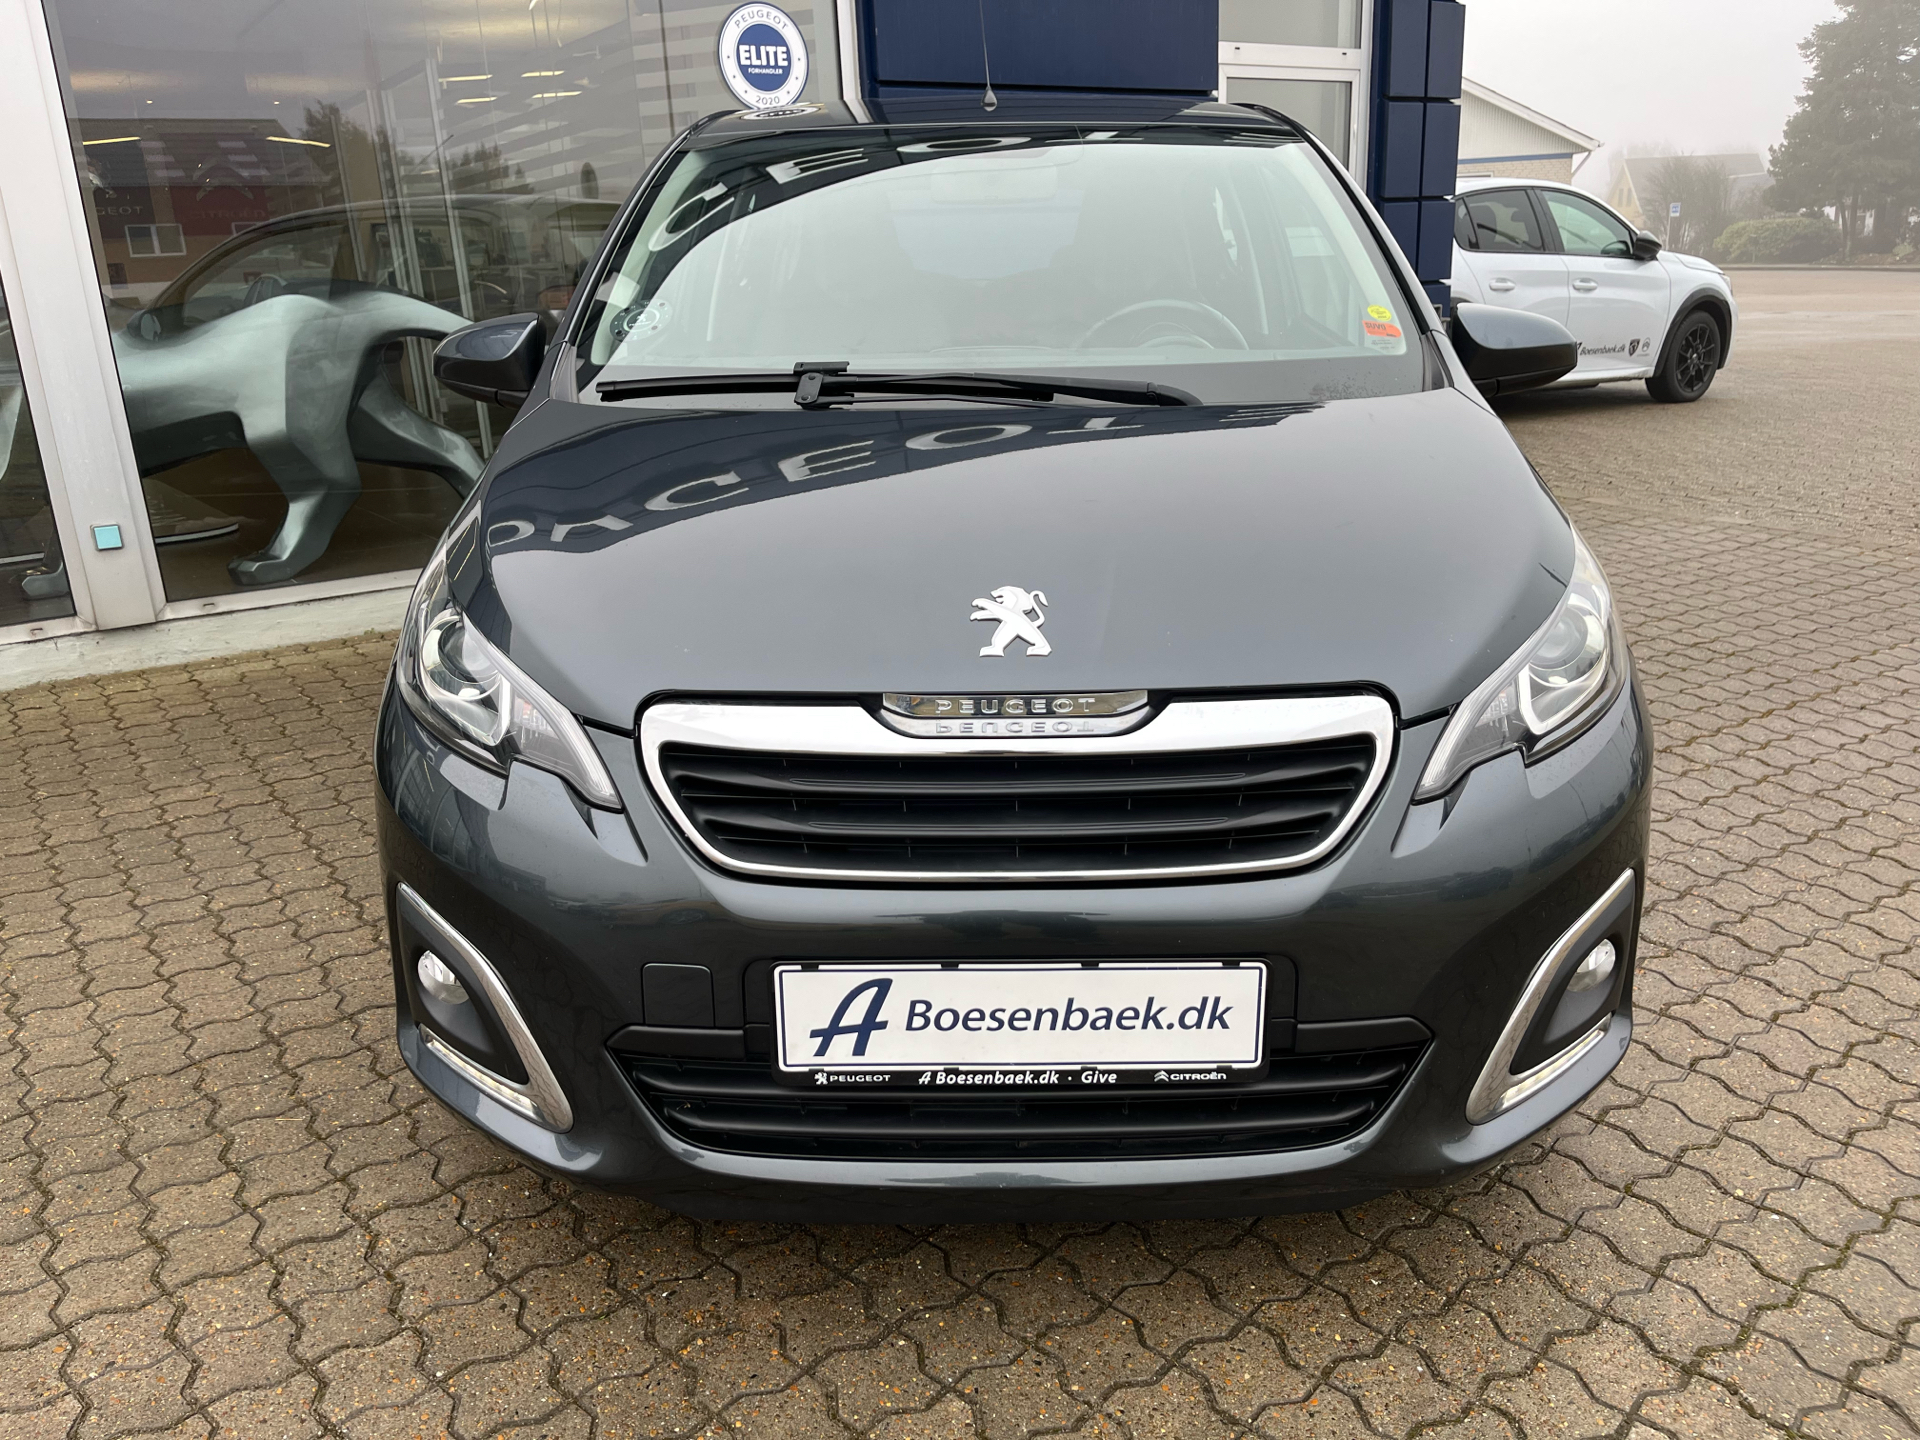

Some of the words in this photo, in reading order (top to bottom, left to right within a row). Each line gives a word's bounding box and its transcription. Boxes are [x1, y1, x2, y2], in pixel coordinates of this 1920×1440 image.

[734, 9, 789, 30] PEUGEOT
[738, 44, 789, 67] ELITE
[748, 67, 783, 75] FORHANDLER
[755, 95, 780, 106] 2020
[935, 697, 1096, 714] PEUGEOT
[905, 996, 1234, 1032] Boesenbaek.dk
[830, 1074, 891, 1083] PEUGEOT
[936, 1070, 1060, 1085] Boesenbaek.dk
[1080, 1070, 1117, 1084] Give
